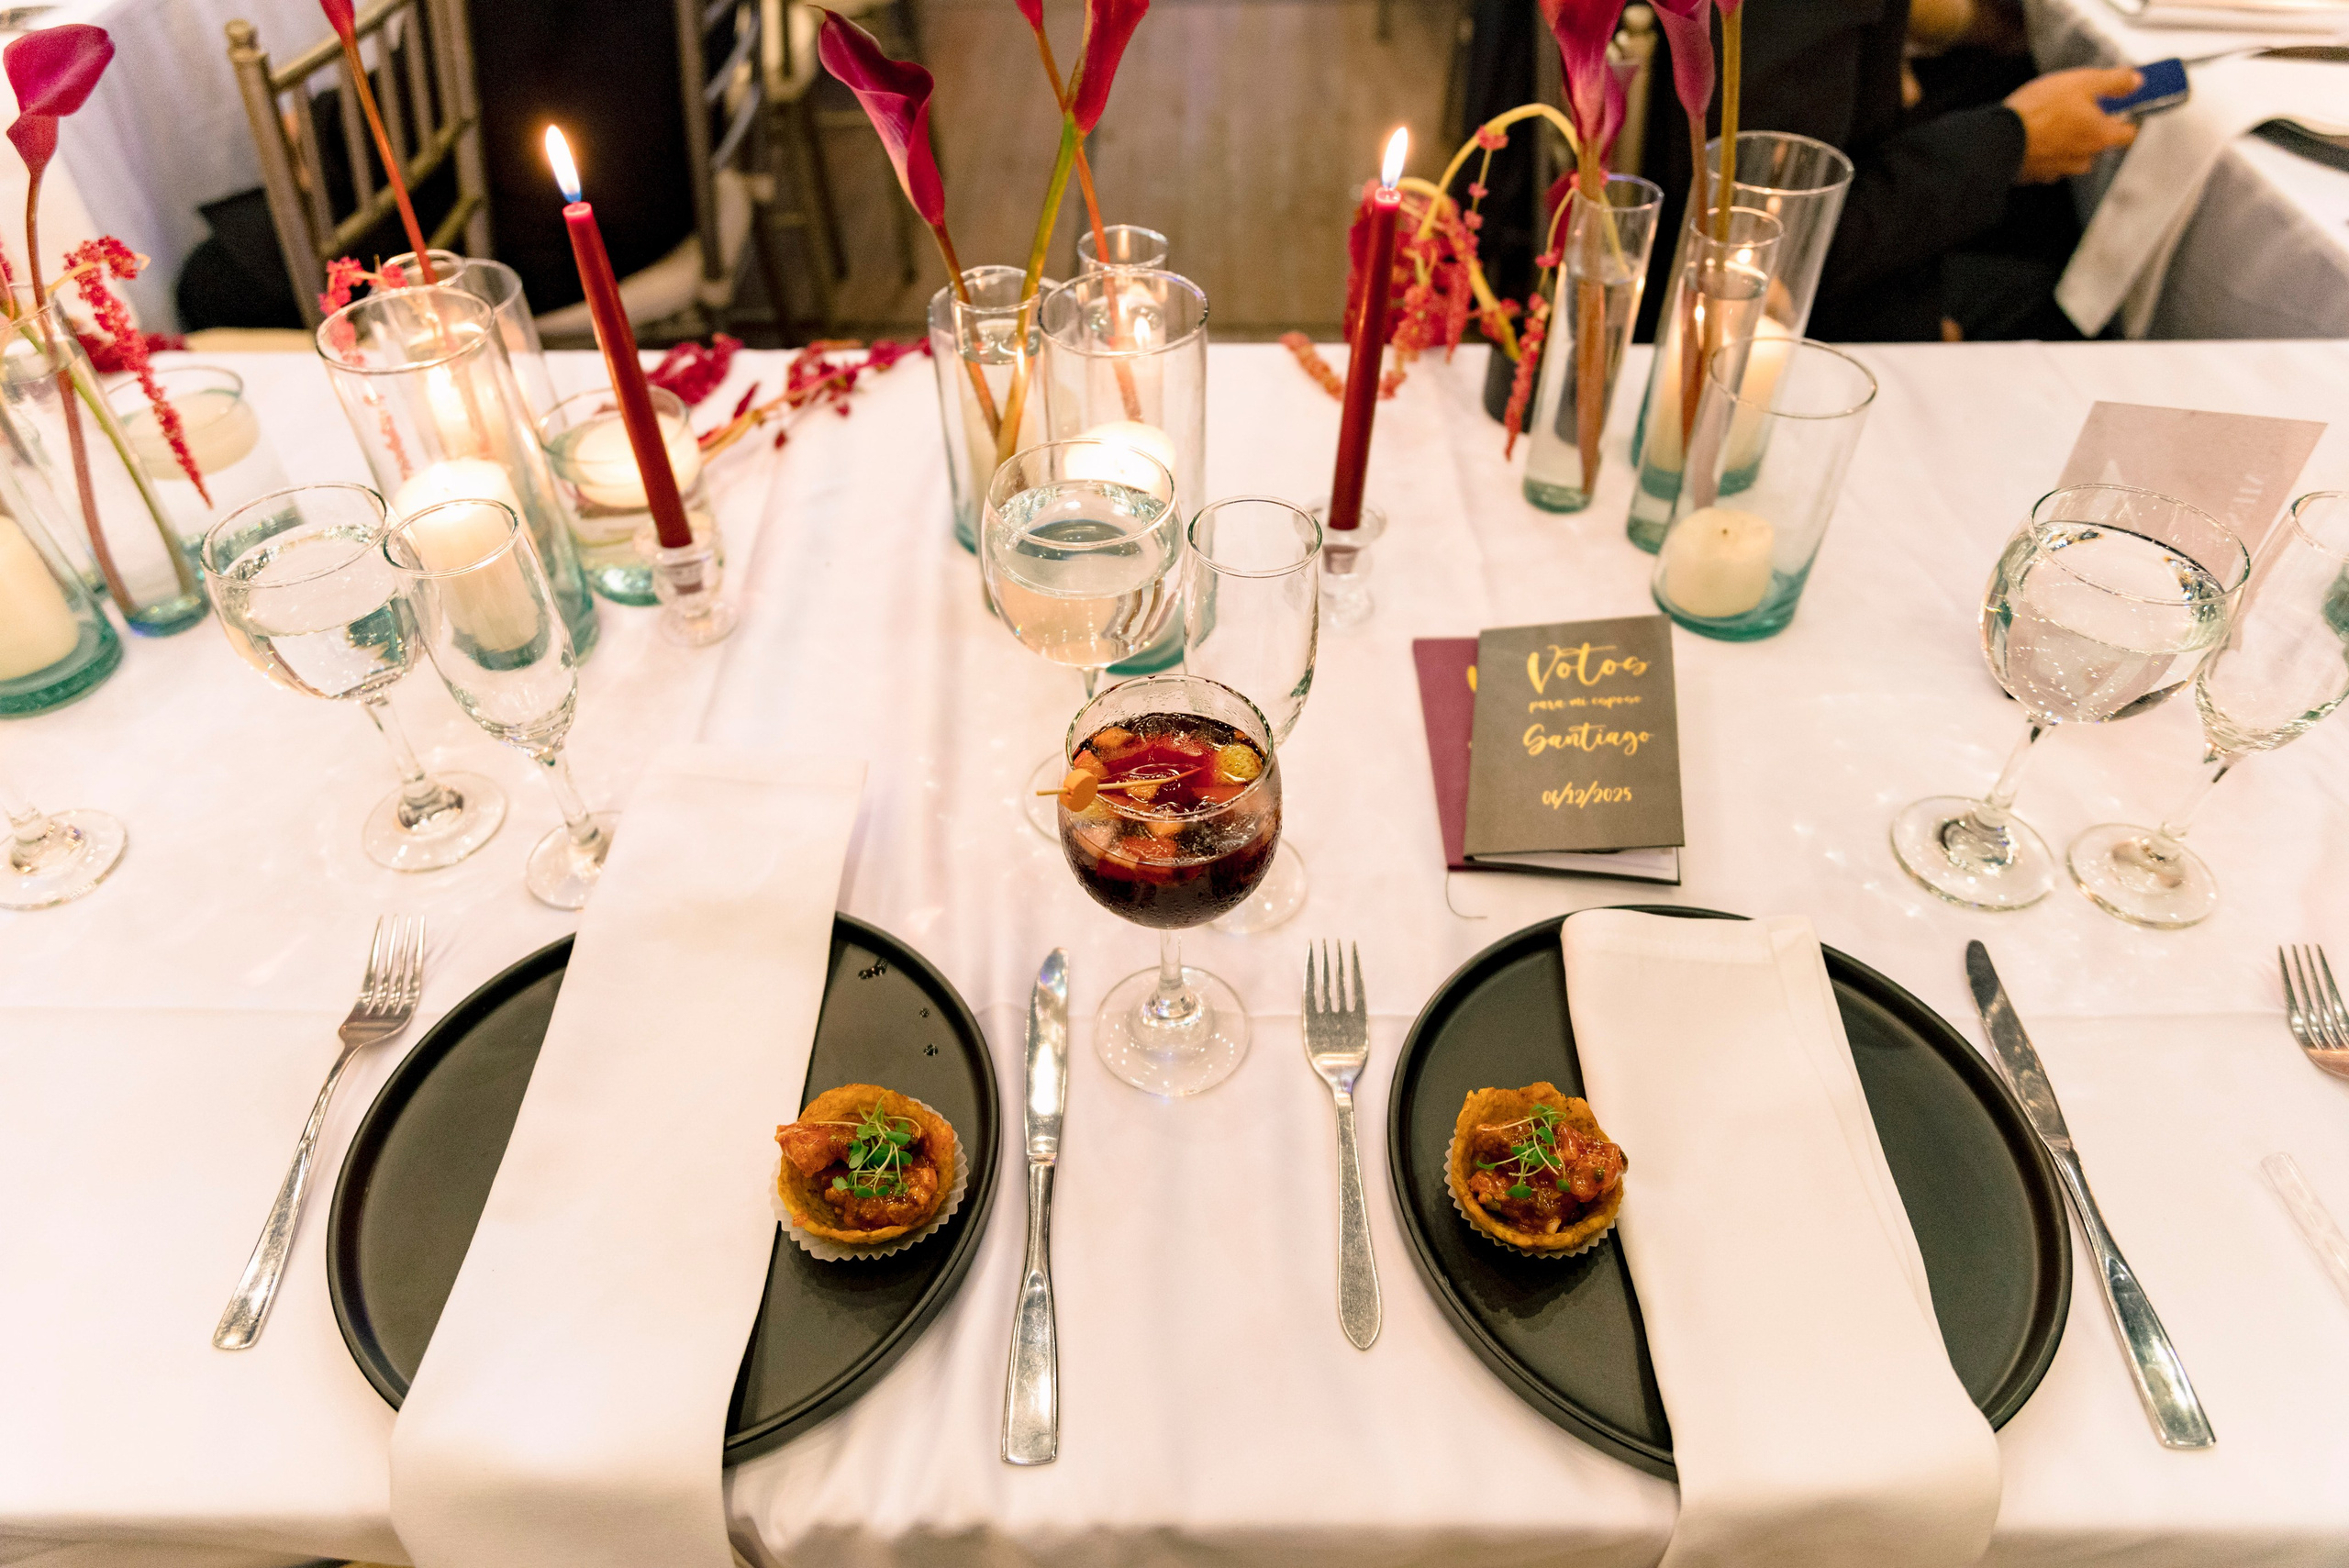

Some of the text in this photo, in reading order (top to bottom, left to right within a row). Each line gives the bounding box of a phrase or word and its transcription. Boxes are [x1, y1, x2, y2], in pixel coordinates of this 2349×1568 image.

[1527, 642, 1648, 695] Votos
[1528, 699, 1565, 714] para
[1568, 696, 1588, 707] mi
[1522, 722, 1651, 756] Santiago
